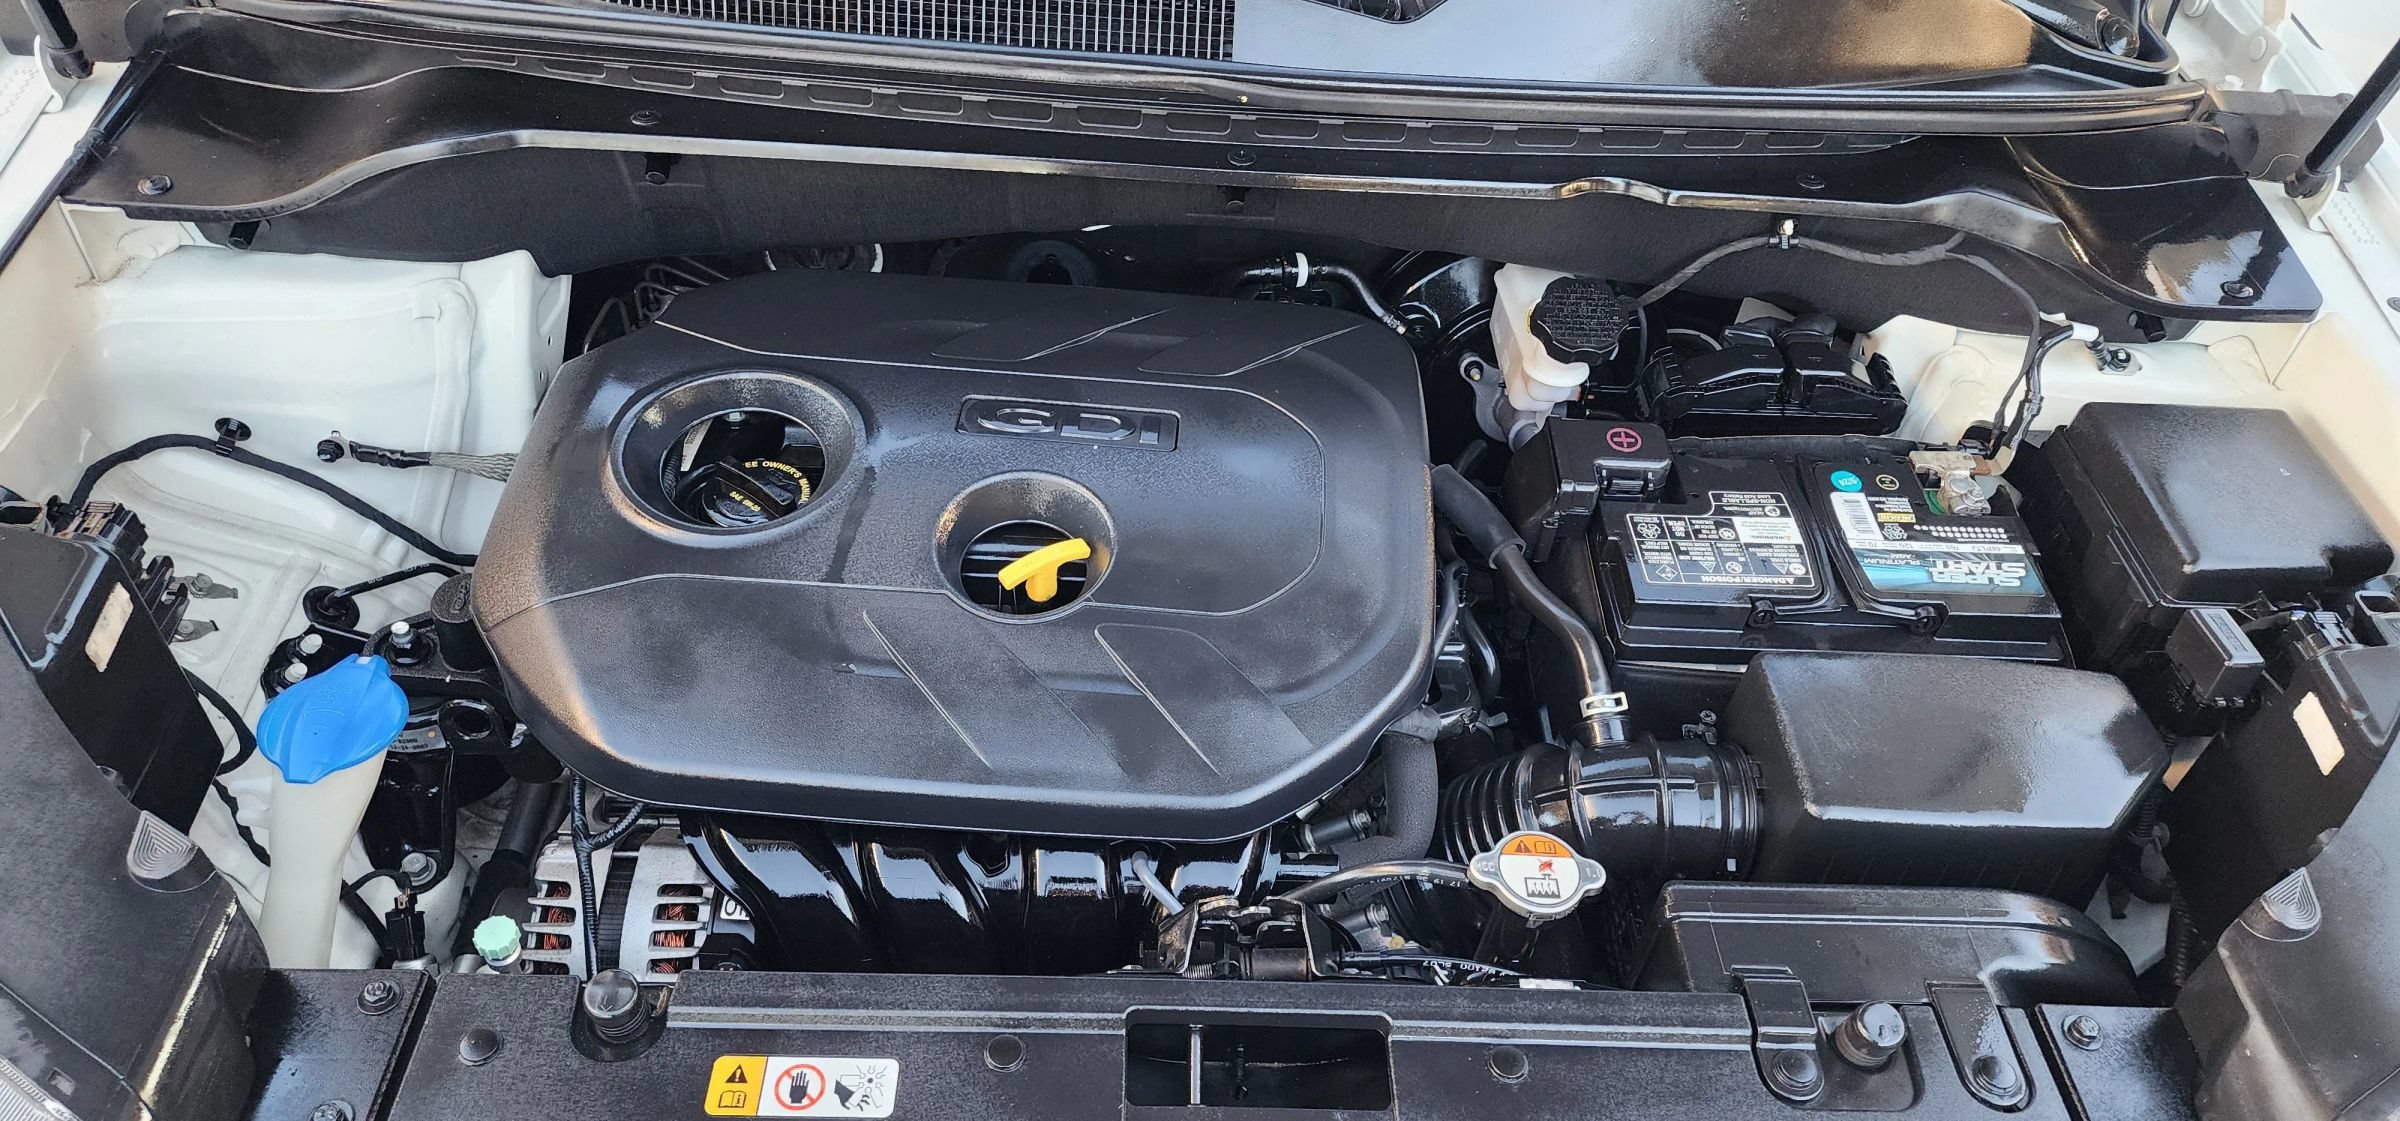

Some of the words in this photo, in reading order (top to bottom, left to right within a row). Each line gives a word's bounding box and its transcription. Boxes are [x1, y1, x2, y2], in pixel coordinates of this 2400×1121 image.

[977, 407, 1161, 445] GDI
[762, 461, 802, 478] OWNER'S
[729, 491, 745, 502] SAE
[1863, 558, 1921, 566] PLATINUM
[1929, 560, 2027, 577] START
[1700, 576, 1787, 585] DANGER/POISON
[1932, 571, 2021, 587] SUPER
